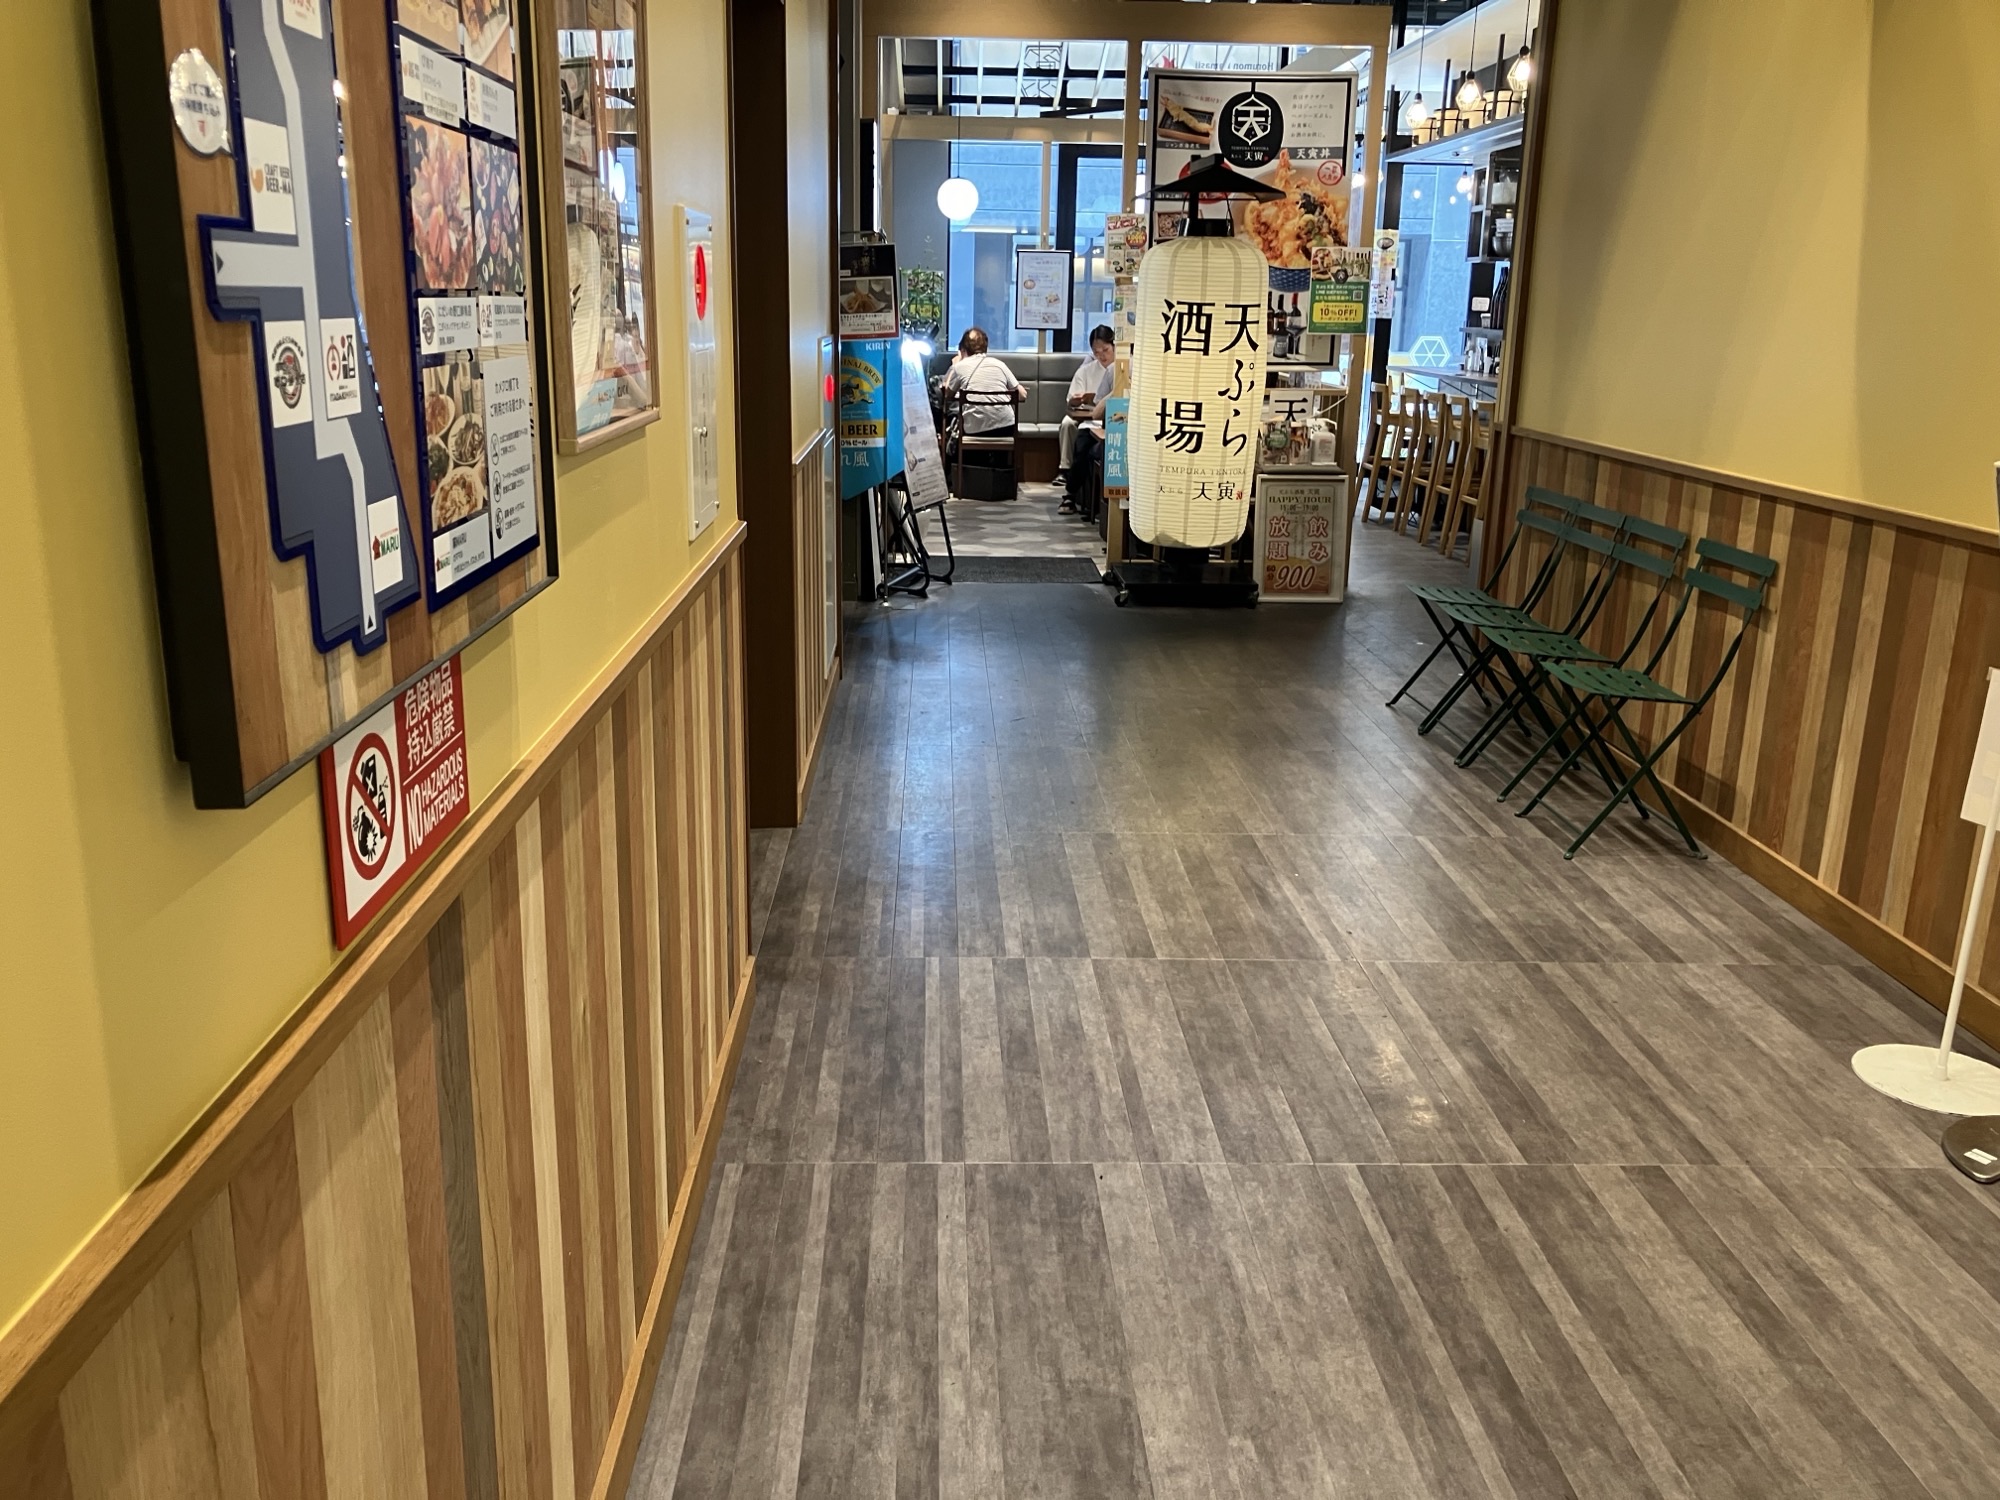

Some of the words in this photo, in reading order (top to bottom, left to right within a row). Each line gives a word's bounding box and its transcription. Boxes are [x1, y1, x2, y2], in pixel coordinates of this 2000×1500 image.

[1296, 147, 1331, 159] 天寅丼
[865, 342, 891, 351] KIRIN
[1154, 299, 1216, 454] 酒場
[1218, 303, 1261, 456] 天ぷら
[847, 424, 878, 436] BEER
[1107, 432, 1122, 478] 晴れ風
[1159, 465, 1206, 475] TEMPURA
[1192, 481, 1236, 501] 天寅
[380, 534, 400, 557] MARU
[1274, 564, 1316, 590] 900
[404, 660, 453, 730] 危険物品
[407, 701, 455, 772] 持込厳禁
[405, 783, 424, 855] NO
[421, 747, 463, 806] HAZARDOUS
[422, 778, 465, 837] MATERIALS
